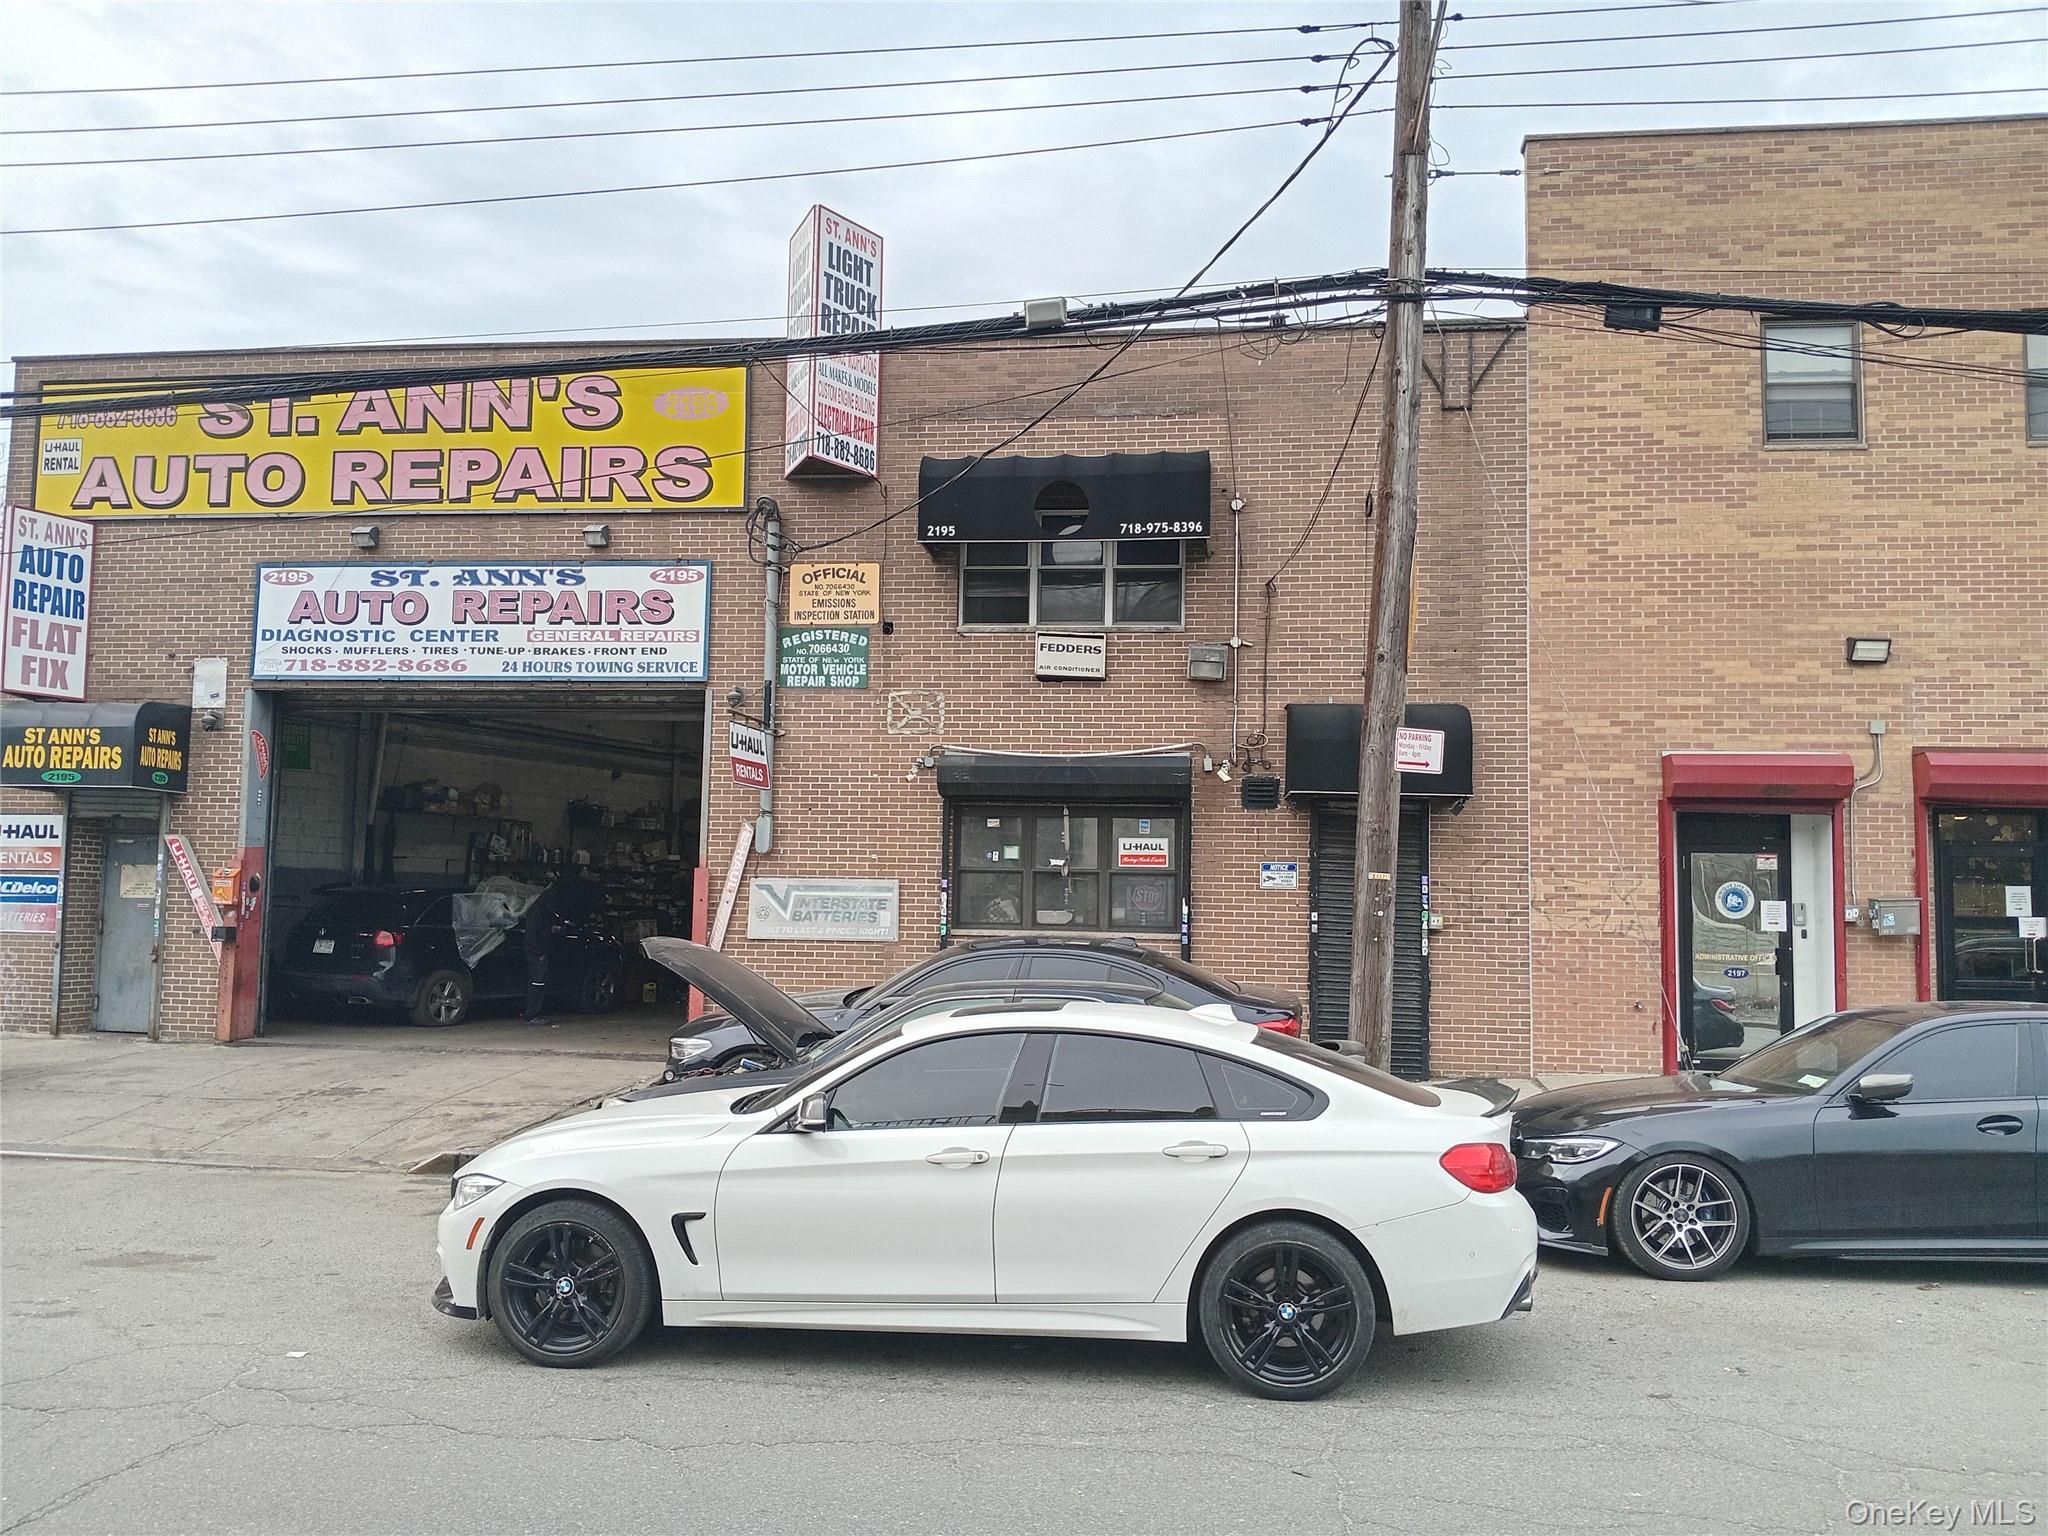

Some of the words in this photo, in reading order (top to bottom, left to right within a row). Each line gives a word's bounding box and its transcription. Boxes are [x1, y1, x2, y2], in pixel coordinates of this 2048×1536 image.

[825, 217, 841, 240] ST.
[844, 227, 877, 258] ANN'S
[828, 241, 874, 288] LIGHT
[823, 271, 877, 321] TRUCK
[818, 360, 829, 378] ALL
[829, 364, 848, 387] MAKES
[853, 375, 877, 397] MODELS
[336, 375, 623, 434] ANN'S
[665, 391, 719, 416] 2195
[817, 402, 852, 438] ELECTRICAL
[853, 414, 875, 446] REPAIR
[44, 441, 81, 453] U-HAUL
[816, 432, 875, 471] 718-882-8686
[43, 456, 79, 472] RENTAL
[70, 452, 306, 510] AUTO
[330, 445, 714, 505] REPAIRS
[18, 515, 39, 540] ST.
[44, 521, 88, 550] ANN'S
[927, 525, 956, 537] 2195
[1120, 521, 1203, 534] 718-975-8396
[19, 544, 84, 584] AUTO
[268, 572, 308, 583] 2195
[370, 569, 440, 587] ST.
[452, 568, 586, 587] ANN'S
[655, 570, 698, 582] 2195
[801, 567, 867, 585] OFFICIAL
[12, 578, 86, 621] REPAIR
[811, 599, 856, 608] EMISSIONS
[287, 590, 429, 625] AUTO
[451, 589, 675, 626] REPAIRS
[794, 610, 840, 621] INSPECTION
[843, 610, 875, 620] STATION
[11, 616, 82, 656] FLAT
[261, 629, 396, 643] DIAGNOSTIC
[409, 629, 499, 642] CENTER
[529, 630, 615, 642] GENERAL
[620, 630, 698, 642] REPAIRS
[782, 630, 868, 649] REGISTERED
[281, 646, 332, 655] SHOCKS
[343, 646, 409, 655] MUFFLERS
[422, 646, 459, 655] TIRES
[469, 646, 525, 656] TUNE-UP
[533, 646, 586, 656] BRAKES
[593, 647, 637, 656] FRONT
[641, 647, 668, 656] END
[808, 643, 850, 654] 7066430
[1039, 643, 1102, 655] FEDDERS
[284, 659, 468, 672] 718-882-8686
[501, 660, 518, 673] 24
[522, 661, 573, 673] HOURS
[576, 661, 633, 673] TOWING
[636, 661, 698, 674] SERVICE
[782, 656, 805, 664] STATE
[808, 656, 820, 664] OF
[843, 656, 865, 664] YORK
[20, 654, 69, 691] FIX
[780, 663, 818, 675] MOTOR
[822, 663, 867, 676] VEHICLE
[1053, 665, 1101, 673] CONDITIONER
[786, 675, 826, 687] REPAIR
[830, 675, 860, 687] SHOP
[24, 728, 45, 744] ST
[48, 728, 101, 745] ANN'S
[148, 728, 157, 743] ST
[157, 730, 177, 746] ANN'S
[731, 731, 765, 756] U-HAUL
[1399, 732, 1408, 740] NO
[1408, 732, 1432, 742] PARKING
[2, 746, 46, 769] AUTO
[49, 746, 122, 770] REPAIRS
[139, 746, 156, 767] AUTO
[156, 748, 182, 771] REPAIRS
[48, 773, 76, 781] 2195
[735, 763, 764, 782] RENTALS
[0, 824, 59, 839] -HAUL
[1123, 842, 1165, 851] U-HAUL
[0, 881, 58, 894] CDelco
[794, 897, 889, 911] INTERSTATE
[792, 910, 878, 923] BATTERIES
[1695, 953, 1749, 961] ADMINISTRATIVE
